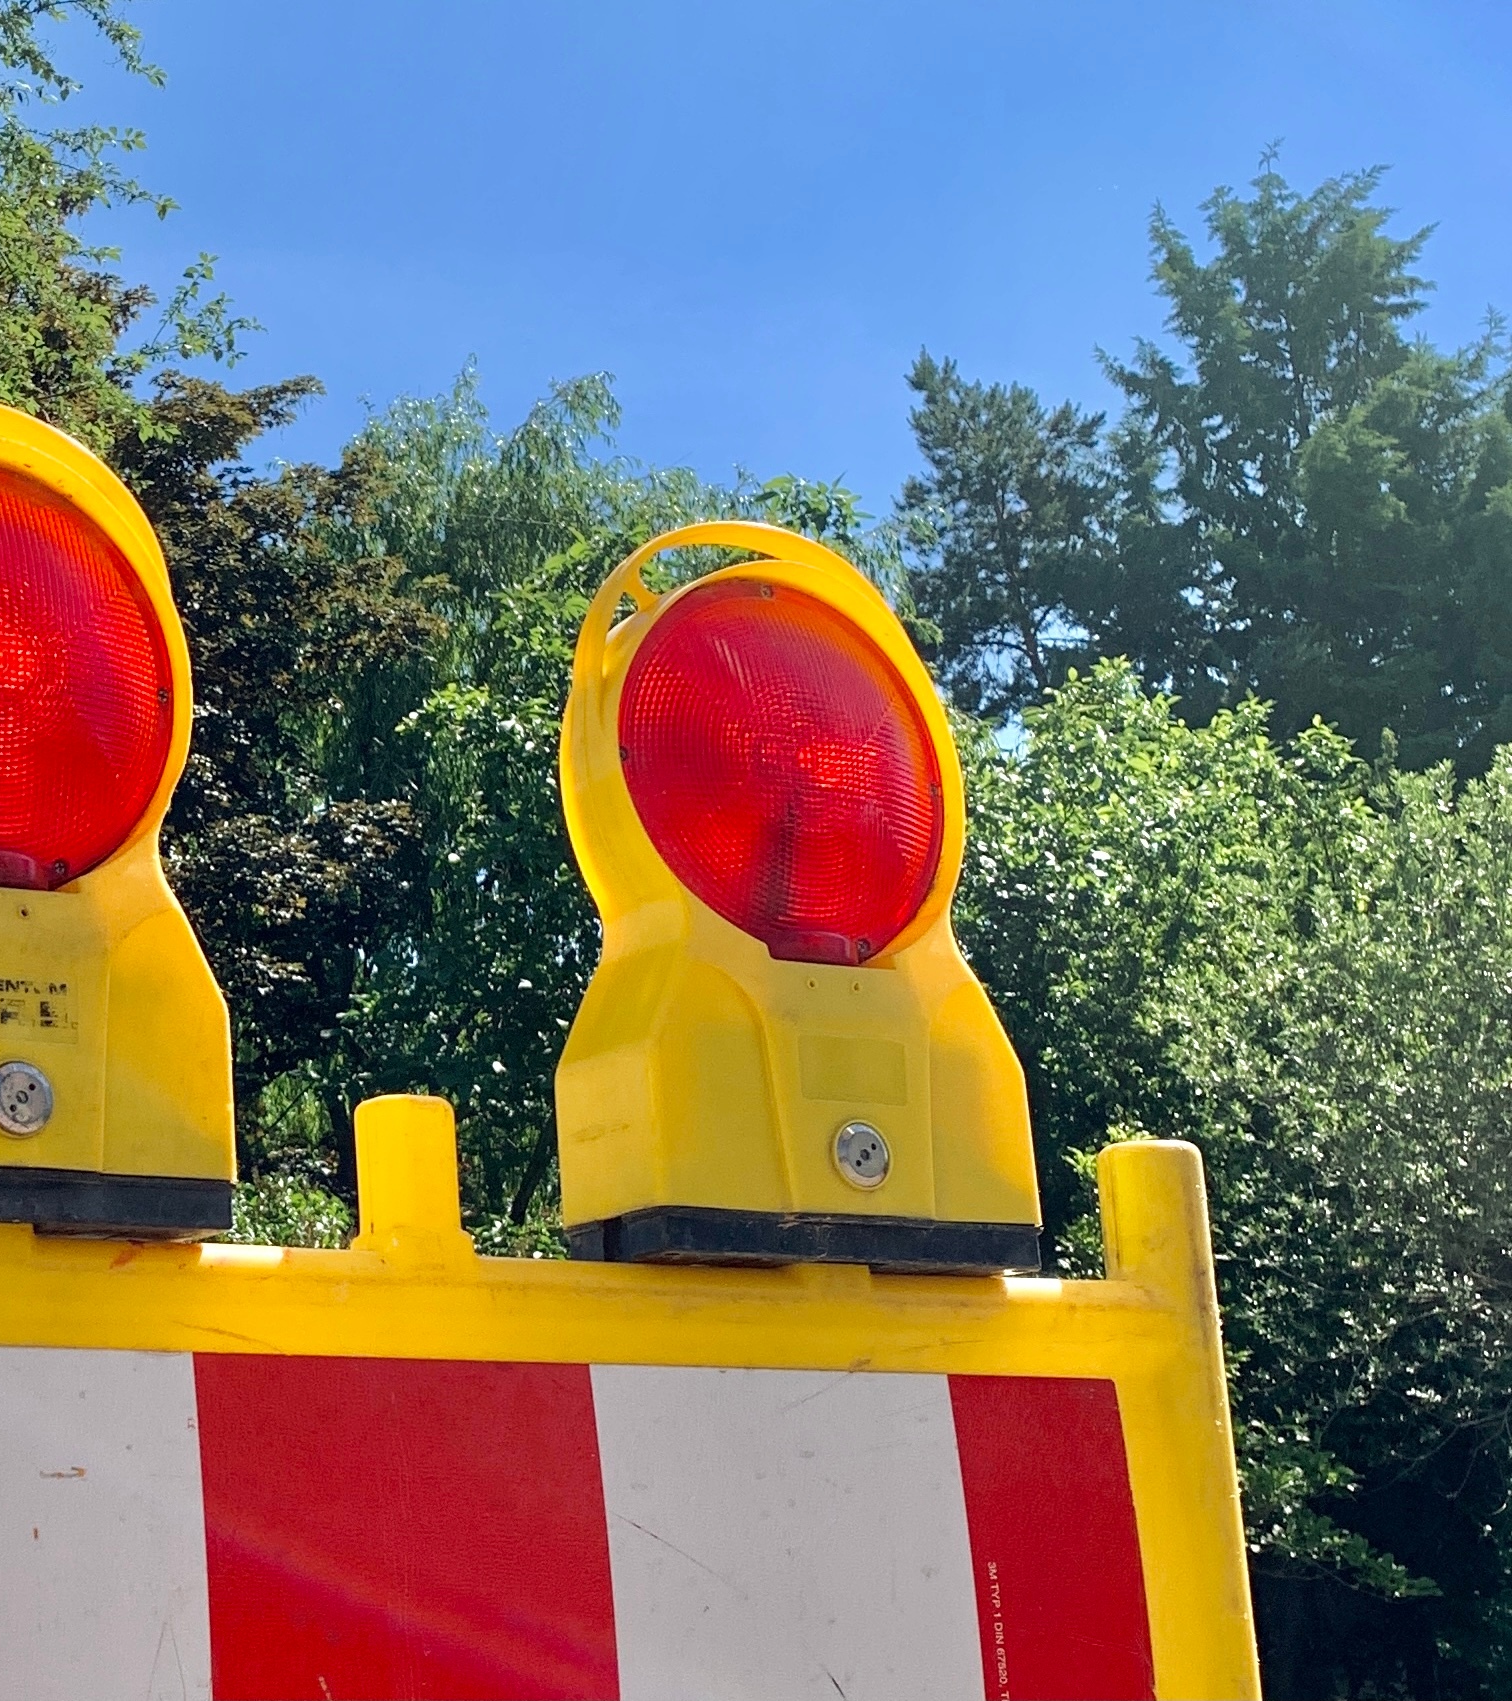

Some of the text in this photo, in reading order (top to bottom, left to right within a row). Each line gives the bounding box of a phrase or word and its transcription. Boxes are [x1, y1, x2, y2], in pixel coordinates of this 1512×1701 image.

[988, 1562, 997, 1580] 3M
[990, 1583, 1001, 1608] TYP
[994, 1622, 1004, 1644] DIN
